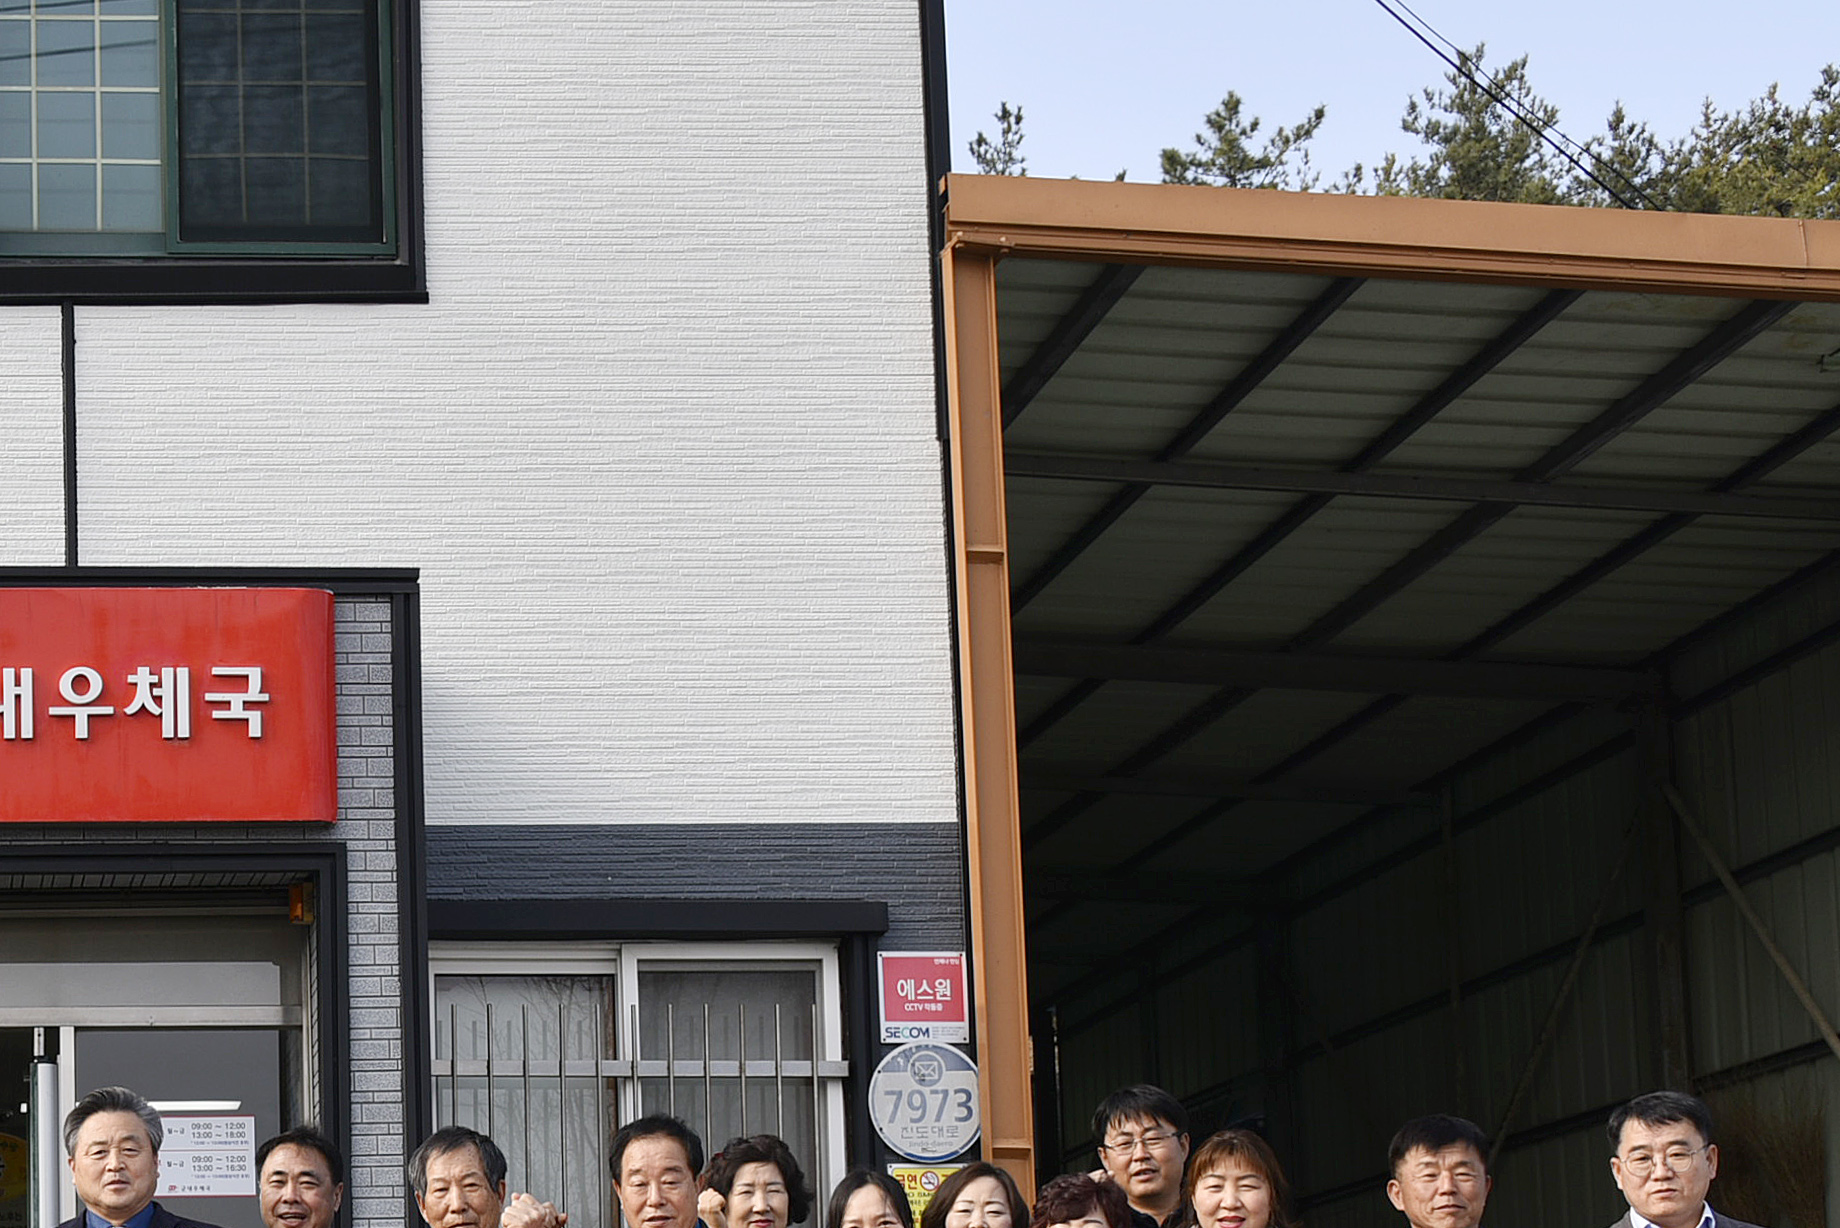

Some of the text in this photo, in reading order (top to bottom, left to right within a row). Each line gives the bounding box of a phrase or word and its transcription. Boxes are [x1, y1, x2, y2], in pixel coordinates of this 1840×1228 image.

[897, 979, 951, 1001] 에스원
[904, 1003, 923, 1011] CCTV
[885, 1027, 930, 1039] SECOM
[884, 1088, 973, 1124] 7973
[191, 1122, 212, 1130] 09:00
[225, 1122, 245, 1130] 12:00
[191, 1131, 213, 1139] 13:00
[225, 1131, 246, 1139] 18:00
[901, 1126, 959, 1139] 진도대로
[191, 1155, 213, 1163] 09:00
[226, 1155, 246, 1163] 12:00
[192, 1164, 213, 1172] 13:00
[226, 1164, 246, 1172] 16:30
